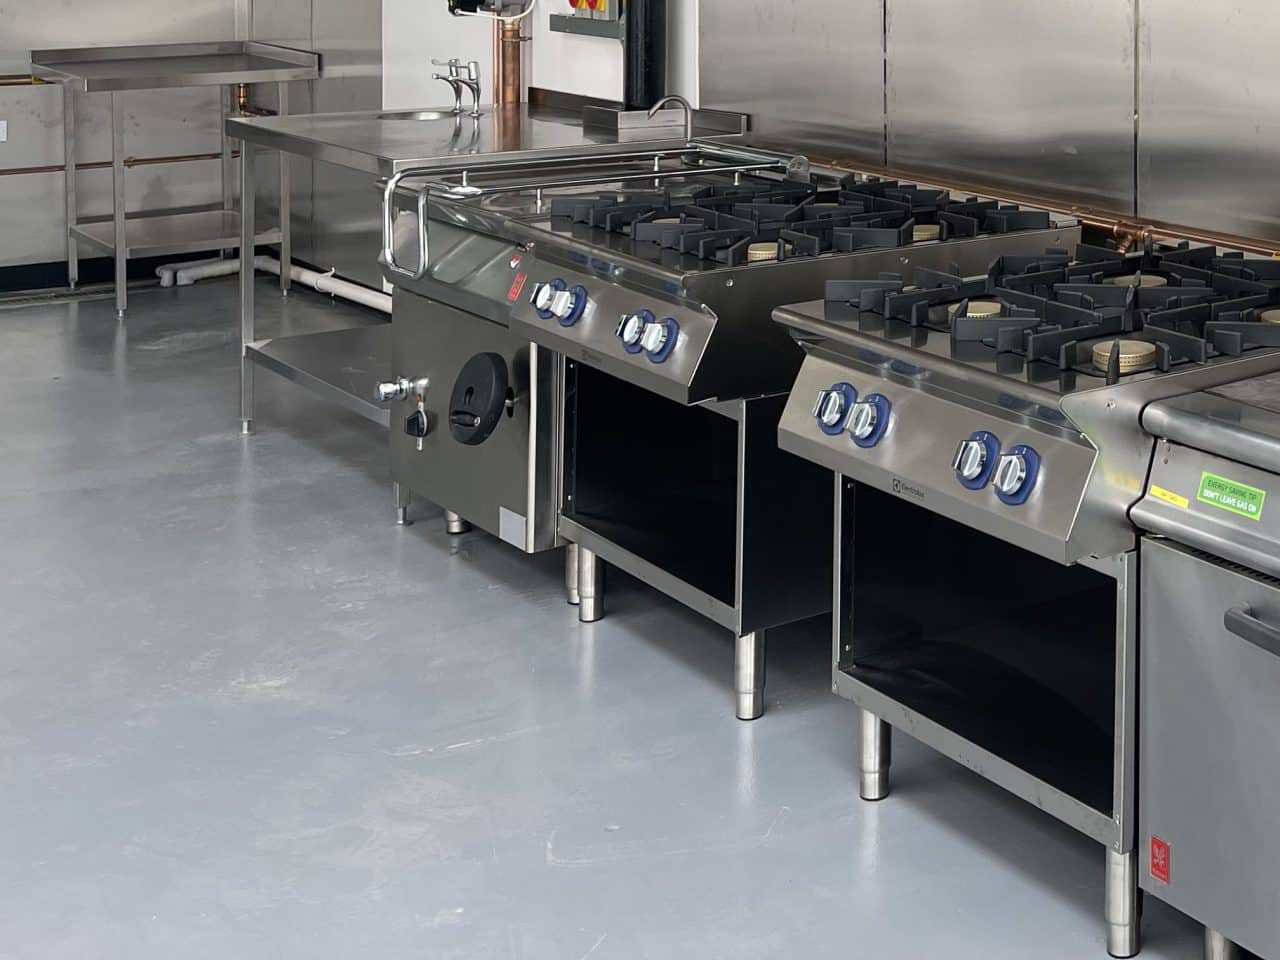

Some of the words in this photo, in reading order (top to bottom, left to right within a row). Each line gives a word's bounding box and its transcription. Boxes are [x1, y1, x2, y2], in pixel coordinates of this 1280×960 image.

[1207, 479, 1228, 491] ENERGY
[1219, 494, 1236, 507] LEAVE
[1236, 499, 1248, 510] GAS
